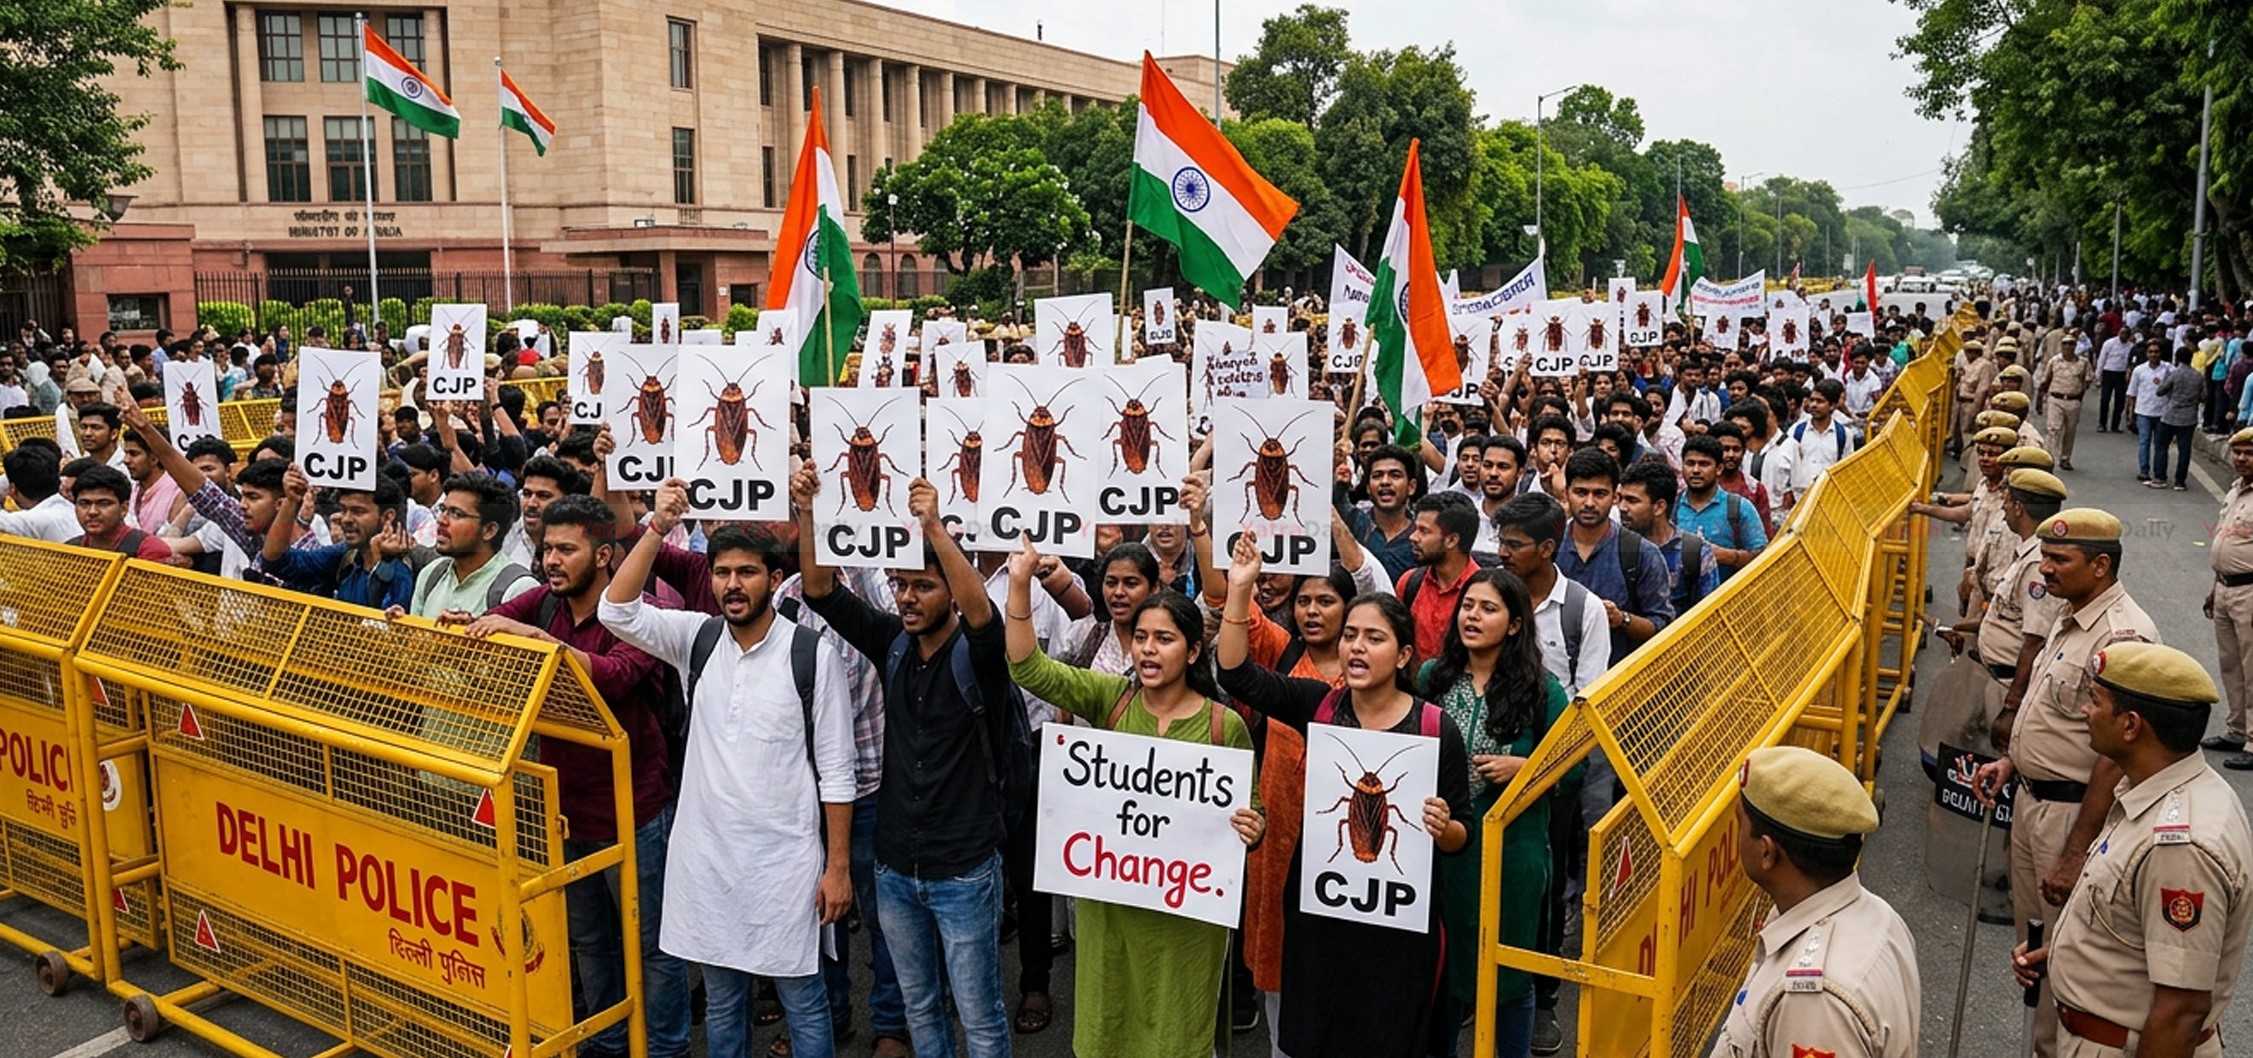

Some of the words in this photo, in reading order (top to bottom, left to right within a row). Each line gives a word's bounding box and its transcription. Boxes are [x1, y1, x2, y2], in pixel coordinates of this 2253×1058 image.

[1536, 357, 1573, 372] CJP
[433, 376, 476, 395] CJP
[1450, 383, 1478, 400] JP
[574, 401, 602, 420] CJ
[304, 452, 367, 481] CJP
[618, 456, 675, 483] CJ
[688, 478, 775, 512] CJP
[1099, 486, 1179, 516] CJP
[828, 523, 911, 559] CJP
[990, 506, 1082, 545] CJP
[0, 727, 74, 793] POLIC
[1116, 800, 1171, 838] for
[216, 801, 315, 890] DELHI
[335, 842, 479, 948] POLICE
[1063, 832, 1224, 909] Change.
[1314, 871, 1417, 917] CJP
[388, 927, 433, 970] दिल्ली
[438, 949, 486, 989] पुलिस
